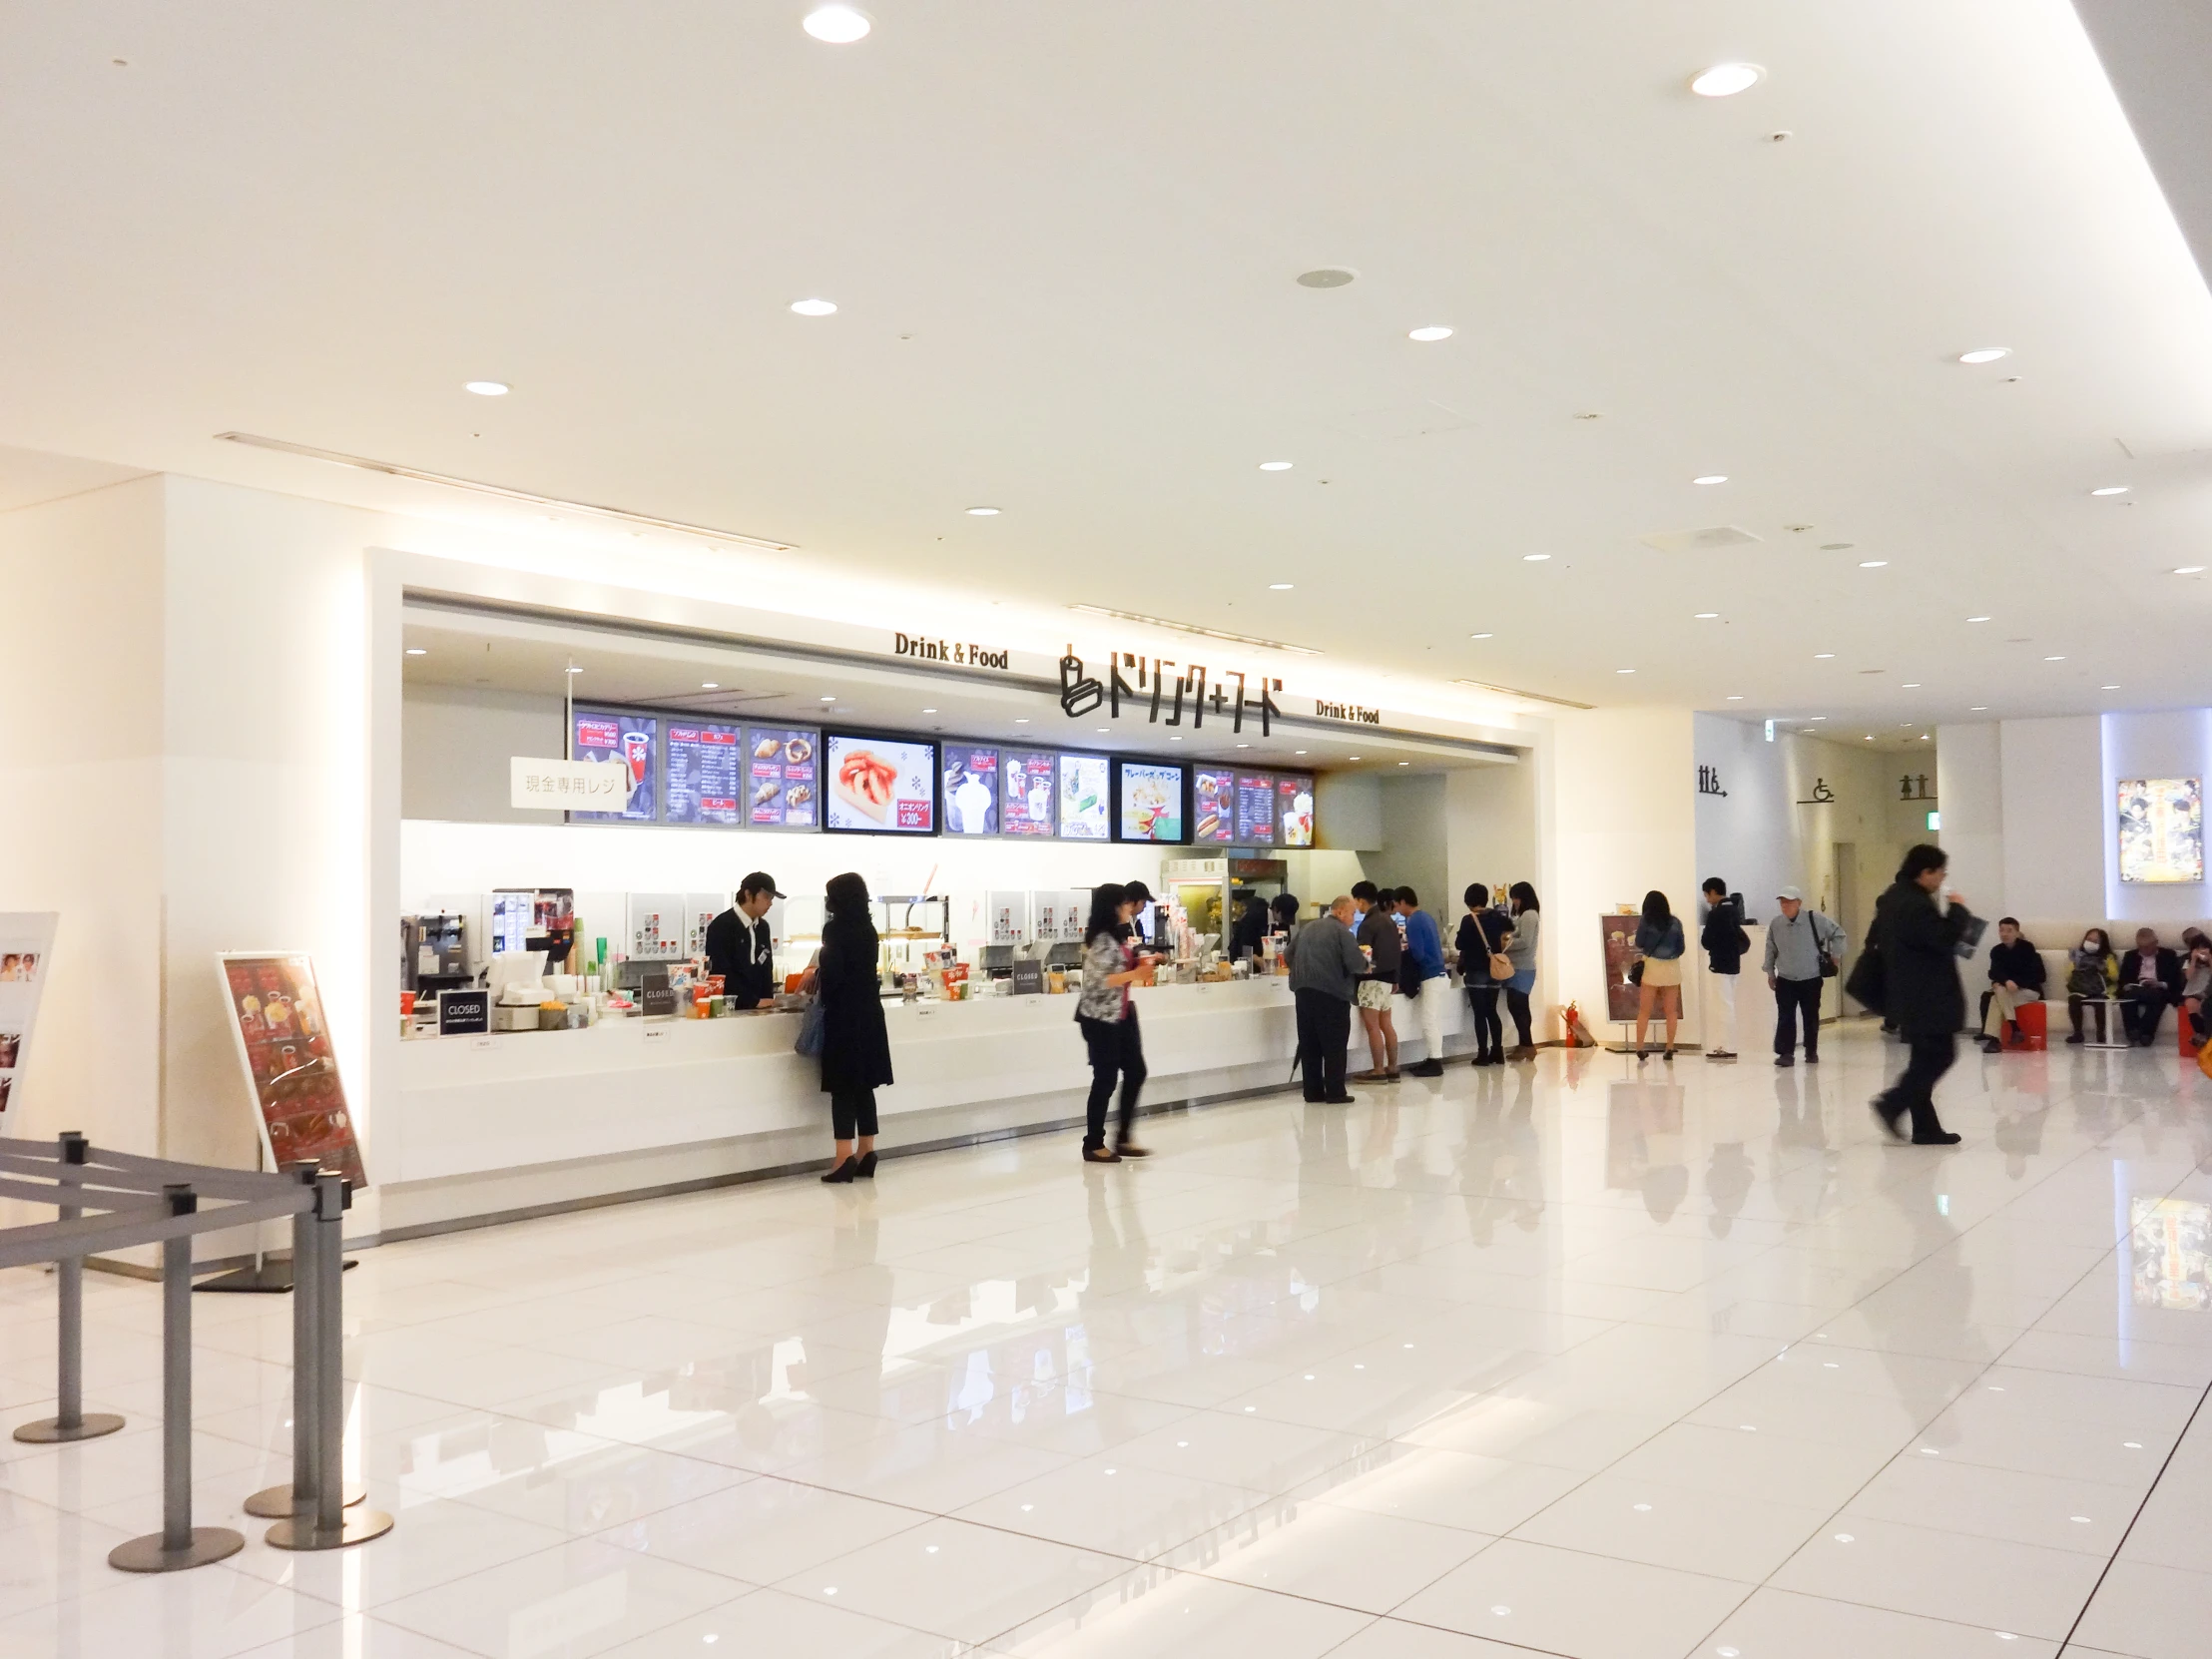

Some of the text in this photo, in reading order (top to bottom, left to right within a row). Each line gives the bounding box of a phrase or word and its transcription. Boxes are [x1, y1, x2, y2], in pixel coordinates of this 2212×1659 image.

[894, 633, 1008, 669] Drink & Food
[1316, 700, 1380, 724] Drink & Food
[525, 775, 615, 795] 現金専用レジ
[898, 802, 929, 812] オニオンリング
[1016, 972, 1038, 981] CLOSED
[646, 989, 675, 999] CLOSED
[448, 1004, 481, 1015] CLOSED
